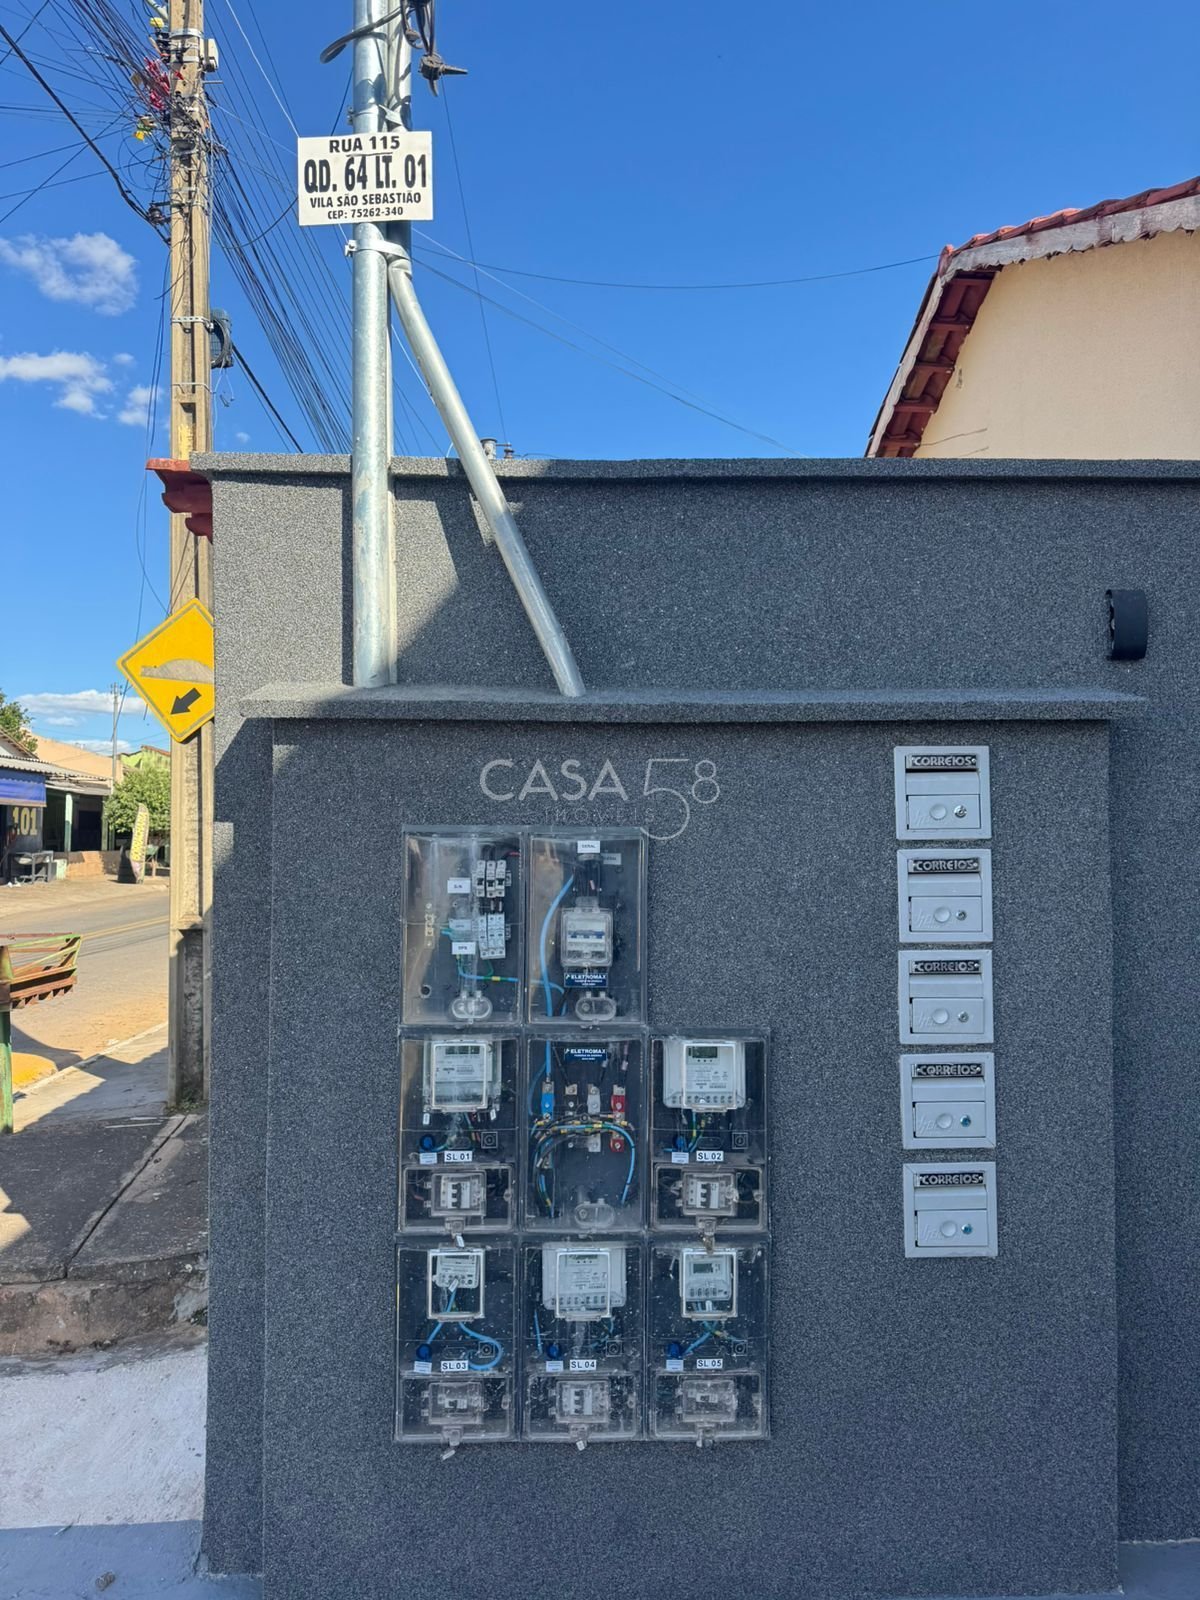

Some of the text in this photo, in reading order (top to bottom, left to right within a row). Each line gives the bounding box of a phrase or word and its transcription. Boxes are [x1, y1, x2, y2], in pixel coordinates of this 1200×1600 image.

[329, 136, 400, 153] RUA 115
[304, 154, 427, 194] QD. 64 LT. 01
[310, 190, 421, 208] VILA SÃO SEBASTIÃO
[327, 206, 404, 220] CEP: 75262-340
[914, 756, 972, 766] CORREIOS
[480, 759, 628, 801] CASA
[12, 807, 38, 835] 101
[916, 859, 974, 871] CORREIOS
[917, 961, 975, 972] CORREIOS
[919, 1064, 977, 1075] CORREIOS
[697, 1152, 709, 1161] SL
[711, 1152, 722, 1161] 02
[921, 1174, 979, 1185] CORREIOS
[442, 1361, 454, 1370] SL
[455, 1361, 466, 1370] 03
[571, 1360, 582, 1369] SL
[584, 1360, 595, 1369] 04
[697, 1359, 722, 1368] SL 05
